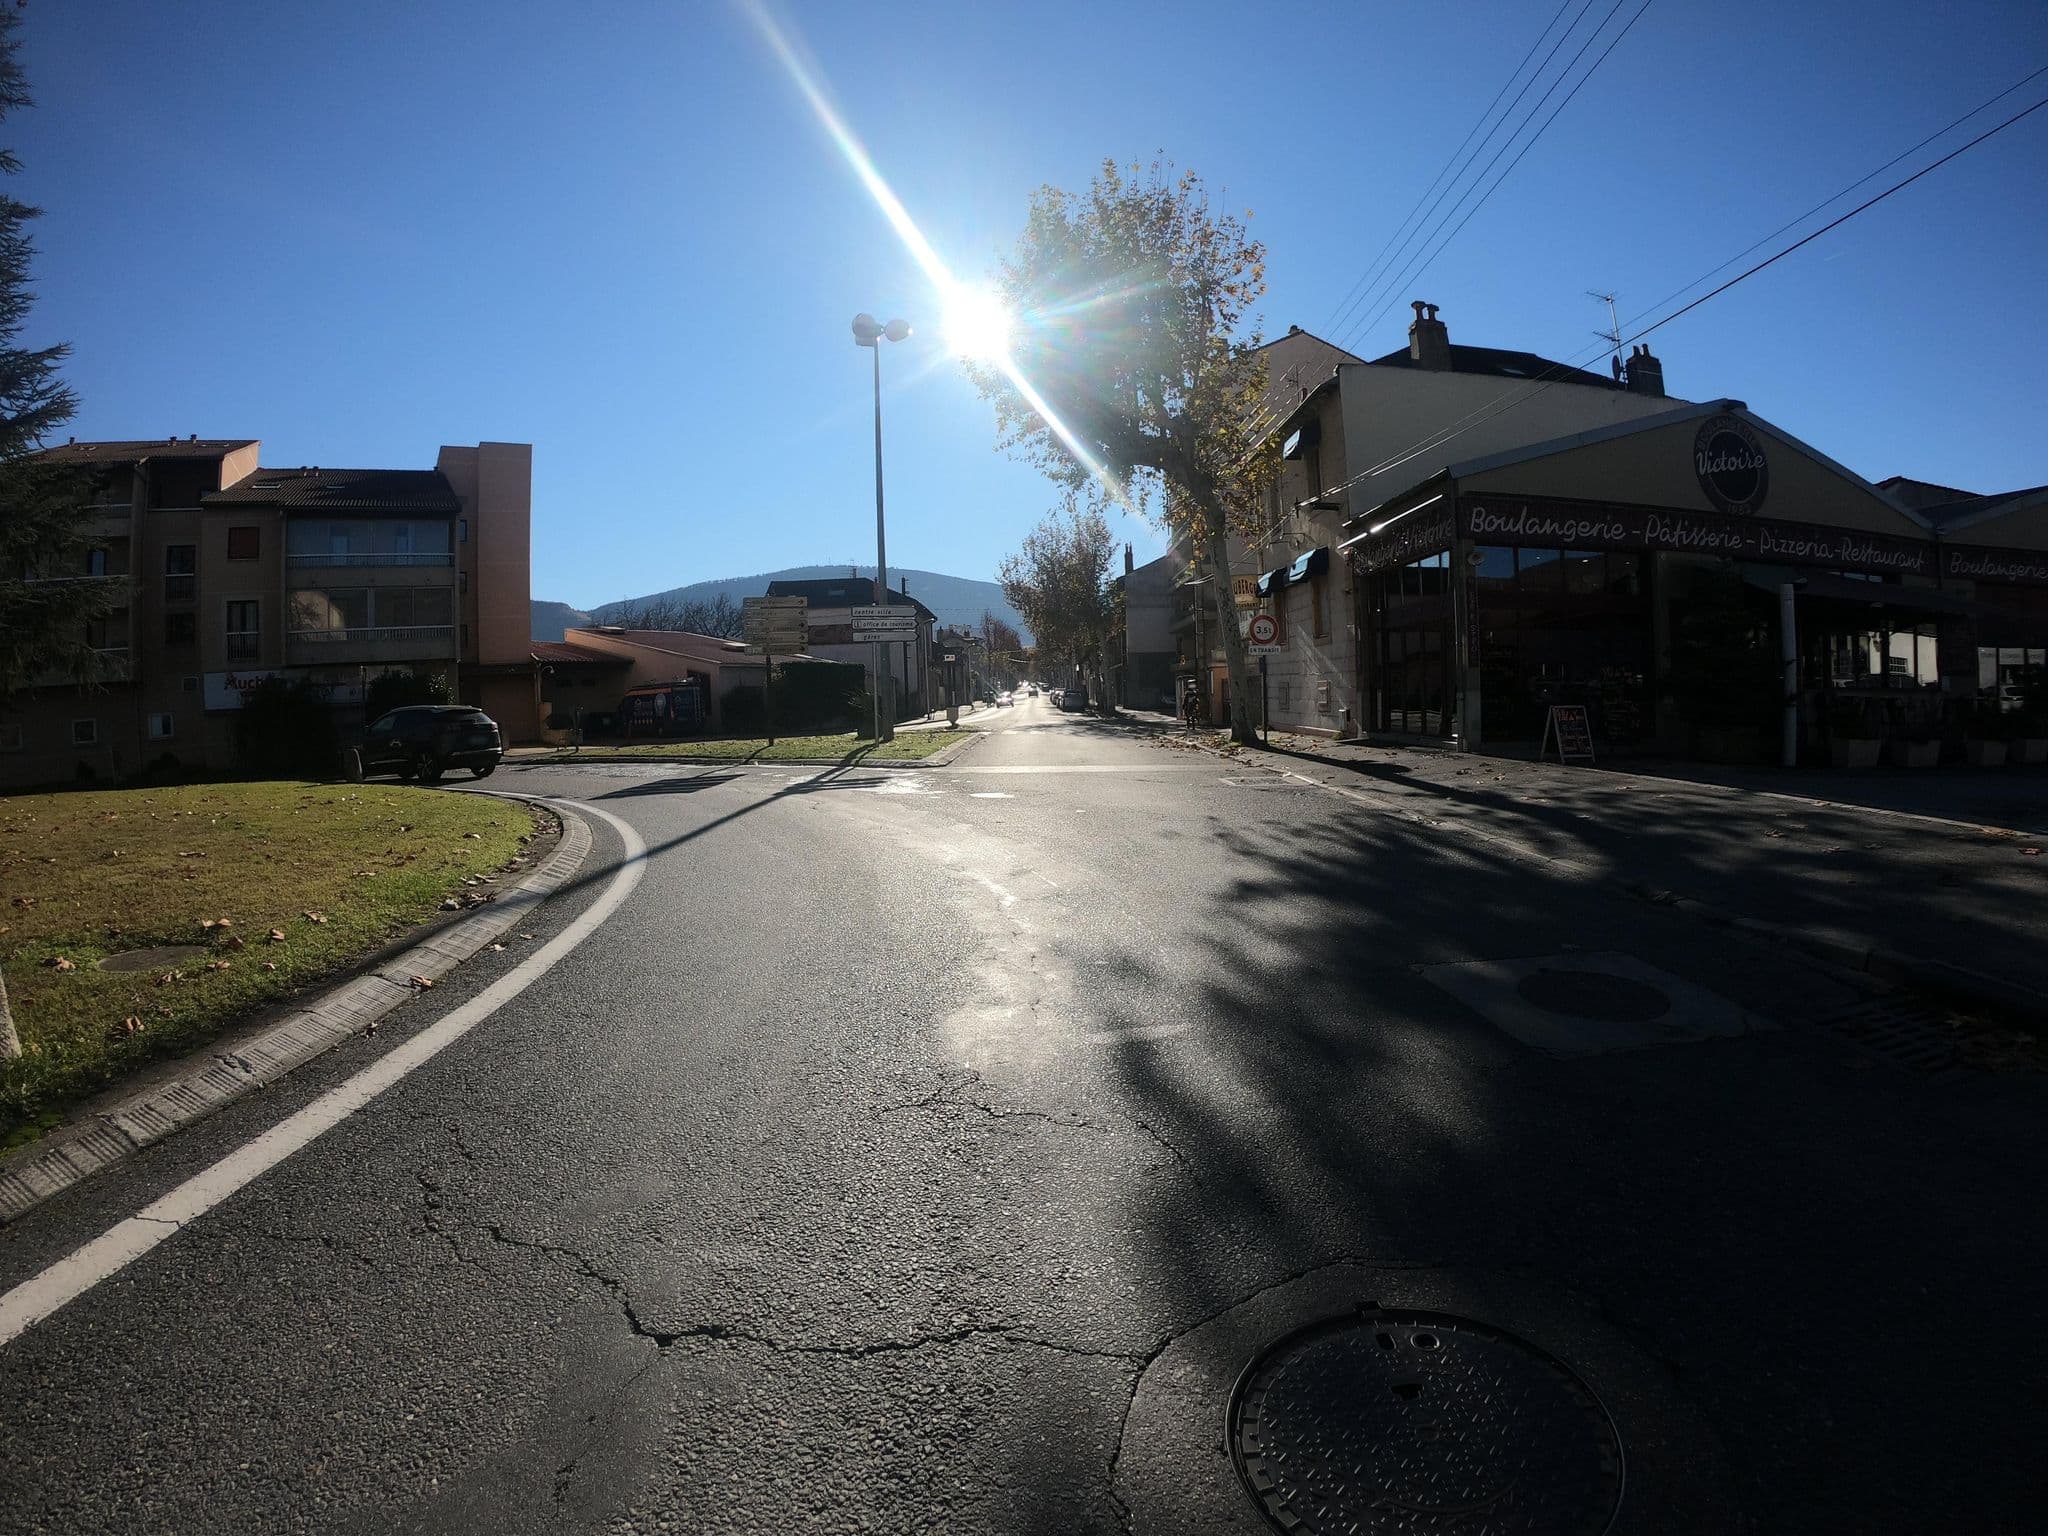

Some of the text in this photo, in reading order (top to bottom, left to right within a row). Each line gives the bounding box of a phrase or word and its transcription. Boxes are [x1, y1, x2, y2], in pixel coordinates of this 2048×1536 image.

[1696, 448, 1765, 475] Victoire
[1470, 506, 1626, 541] Boulangerie
[1645, 515, 1743, 549] Pâtisserie
[1951, 552, 2048, 582] Boulangerie
